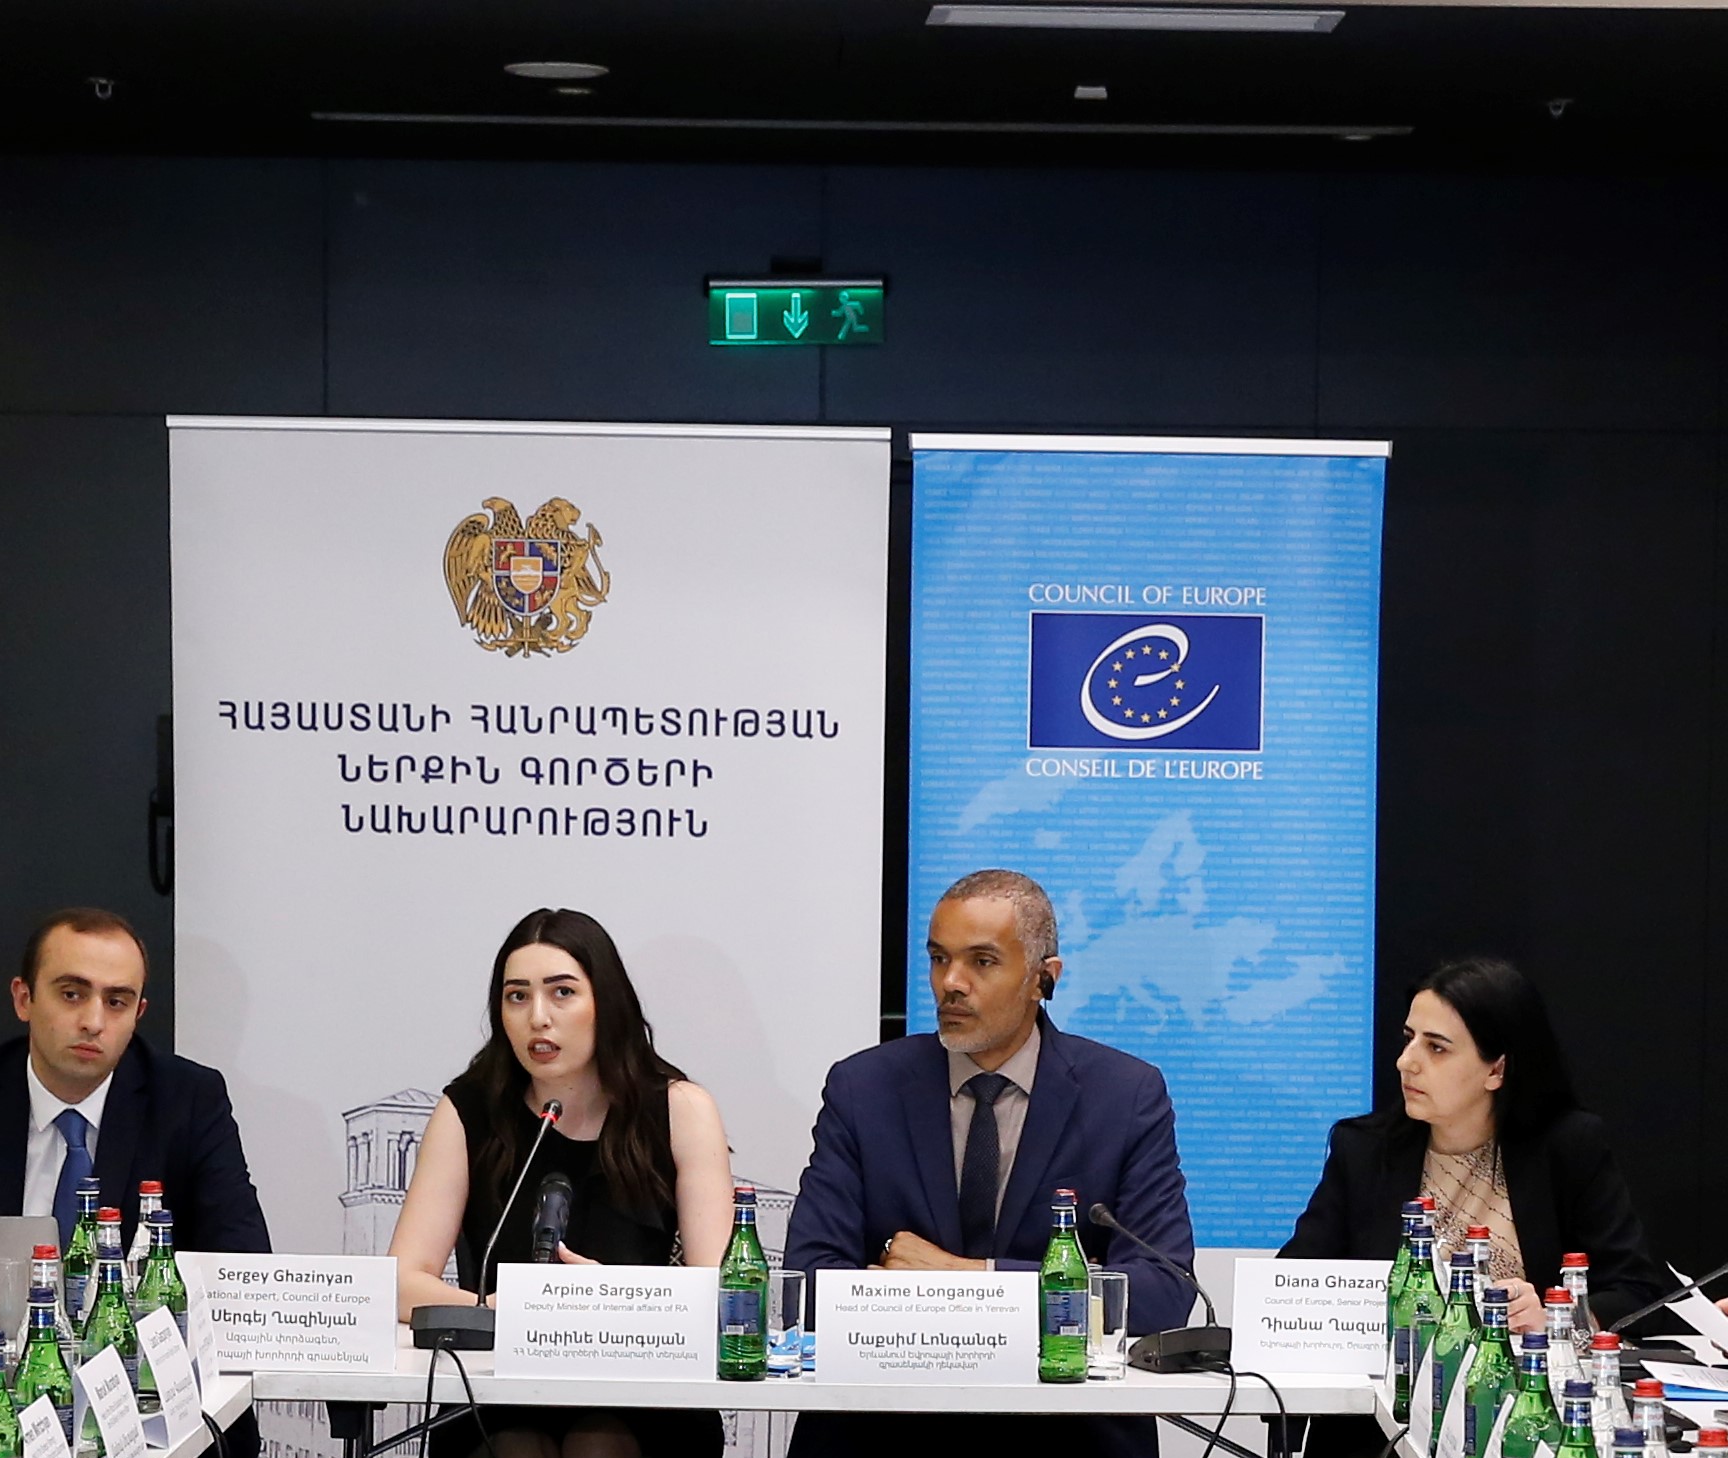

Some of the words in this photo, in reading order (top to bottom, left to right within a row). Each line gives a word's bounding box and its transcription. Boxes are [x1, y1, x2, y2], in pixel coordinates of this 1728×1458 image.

[1028, 583, 1134, 604] COUNCIL
[1142, 585, 1173, 604] OF
[1183, 586, 1266, 606] EUROPE
[218, 701, 451, 732] ՀԱՅԱՍՏԱՆԻ
[471, 704, 839, 739] ՀԱՆՐԱՊԵՏՈՒԹՅԱՆ
[337, 754, 500, 784] ՆԵՐՔԻՆ
[520, 756, 713, 788] ԳՈՐԾԵՐԻ
[1025, 758, 1121, 778] CONSEIL
[1129, 760, 1156, 778] DE
[1164, 760, 1263, 780] L'EUROPE
[341, 804, 708, 838] ՆԱԽԱՐԱՐՈՒԹՅՈՒՆ
[218, 1267, 269, 1284] Sergey
[273, 1269, 353, 1286] Ghazinyan
[1275, 1274, 1319, 1288] Diana
[1325, 1275, 1387, 1292] Ghazary
[206, 1290, 242, 1300] ational
[244, 1292, 280, 1302] expert,
[282, 1292, 319, 1303] Council
[322, 1292, 333, 1303] of
[335, 1293, 371, 1305] Europe
[542, 1283, 594, 1298] Arpine
[598, 1284, 673, 1300] Sargsyan
[851, 1285, 911, 1297] Maxime
[917, 1285, 1005, 1300] Longangué
[524, 1302, 554, 1312] Deputy
[557, 1302, 590, 1311] Minister
[592, 1303, 601, 1311] of
[603, 1303, 634, 1312] Internal
[664, 1303, 673, 1312] of
[675, 1304, 689, 1312] RA
[835, 1303, 858, 1312] Head
[860, 1303, 869, 1312] of
[871, 1303, 902, 1312] Council
[905, 1304, 914, 1312] of
[916, 1304, 946, 1313] Europe
[948, 1303, 973, 1312] Office
[975, 1304, 983, 1312] in
[985, 1305, 1020, 1313] Yerevan
[1264, 1297, 1293, 1305] Council
[1296, 1297, 1303, 1305] of
[1337, 1298, 1361, 1306] Senior
[1364, 1299, 1386, 1308] Proje
[211, 1308, 266, 1327] Սերգեյ
[272, 1310, 357, 1329] Ղազինյան
[1261, 1317, 1322, 1333] Դիանա
[526, 1330, 593, 1347] Արփինե
[598, 1331, 685, 1348] Սարգսյան
[848, 1332, 916, 1348] Մաքսիմ
[921, 1333, 1007, 1348] Լոնգանգե
